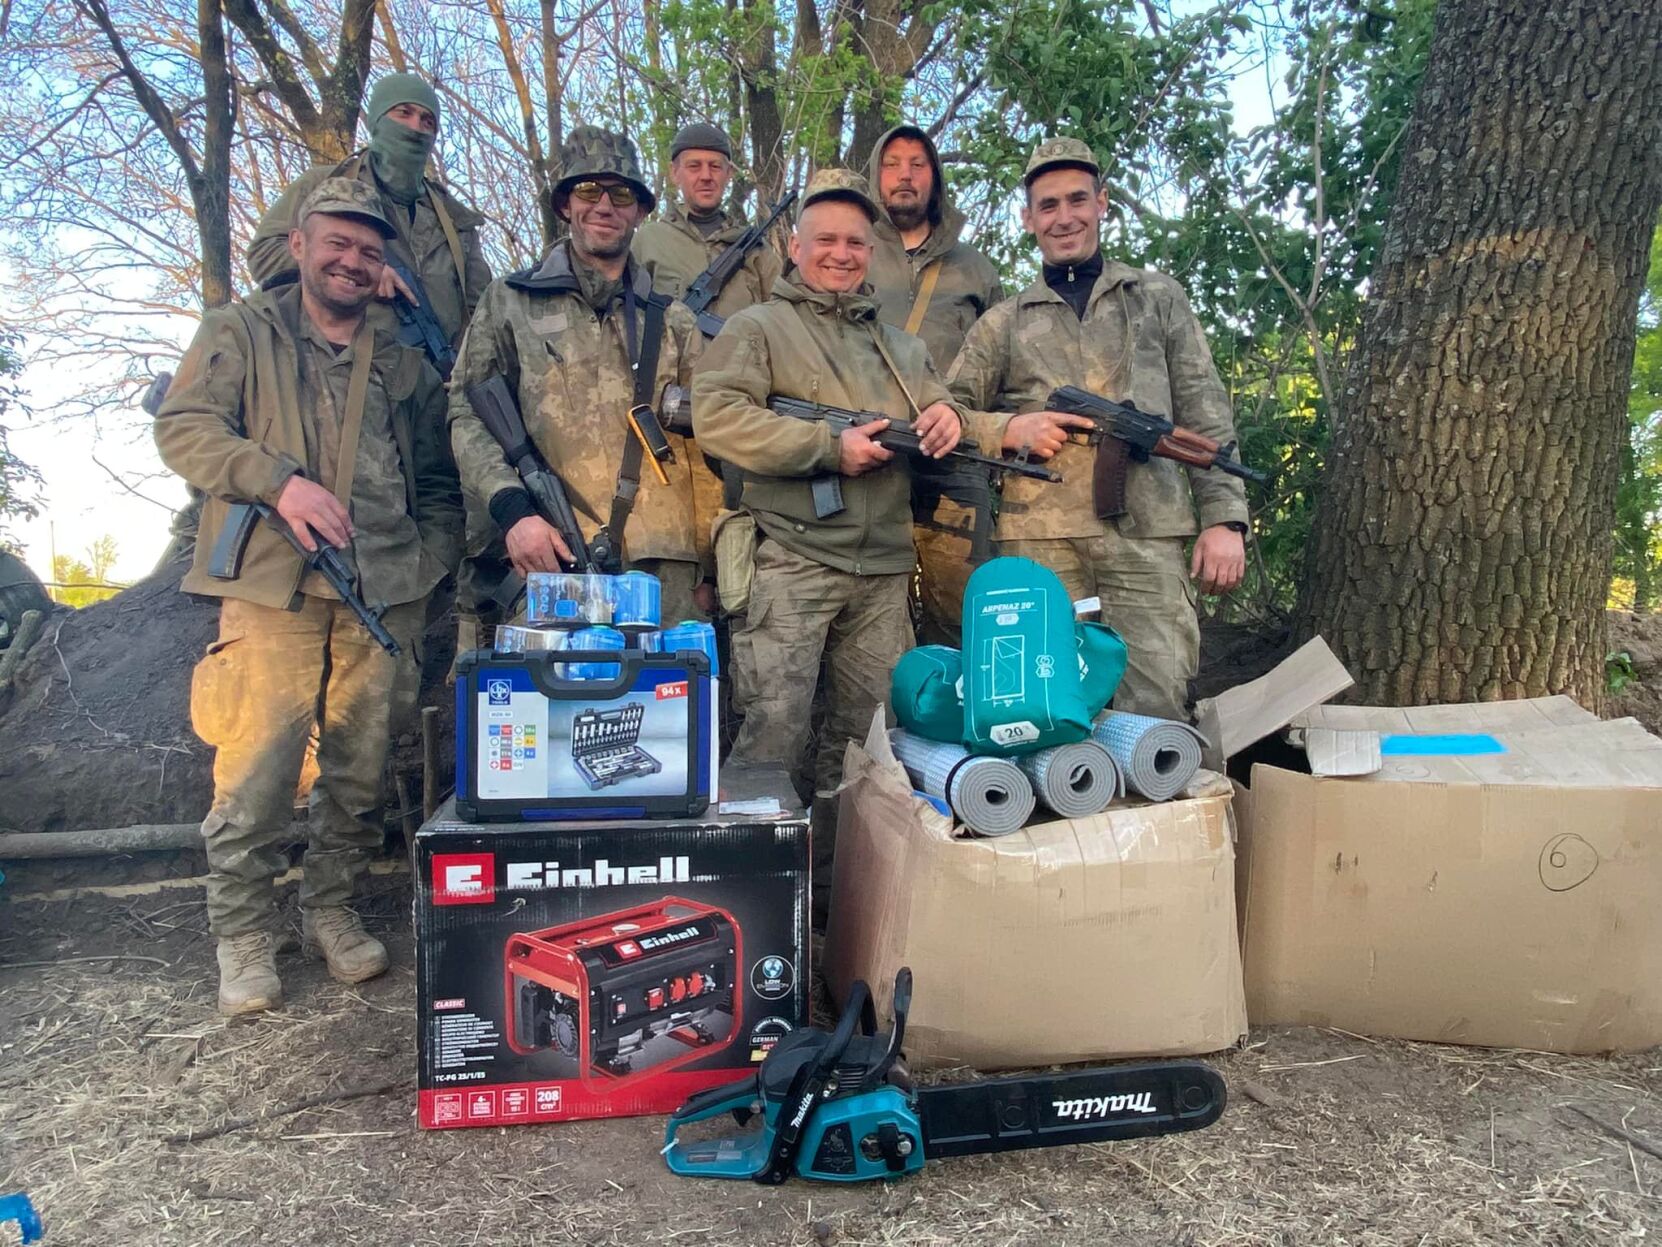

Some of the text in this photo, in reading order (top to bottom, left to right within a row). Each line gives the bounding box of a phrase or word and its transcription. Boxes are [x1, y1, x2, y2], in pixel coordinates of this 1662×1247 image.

[1004, 726, 1024, 738] 20
[506, 856, 690, 889] Einhell
[639, 926, 700, 950] Einhell
[435, 999, 464, 1009] CLASSIC
[434, 1074, 457, 1082] TC-PG
[537, 1090, 560, 1102] 208
